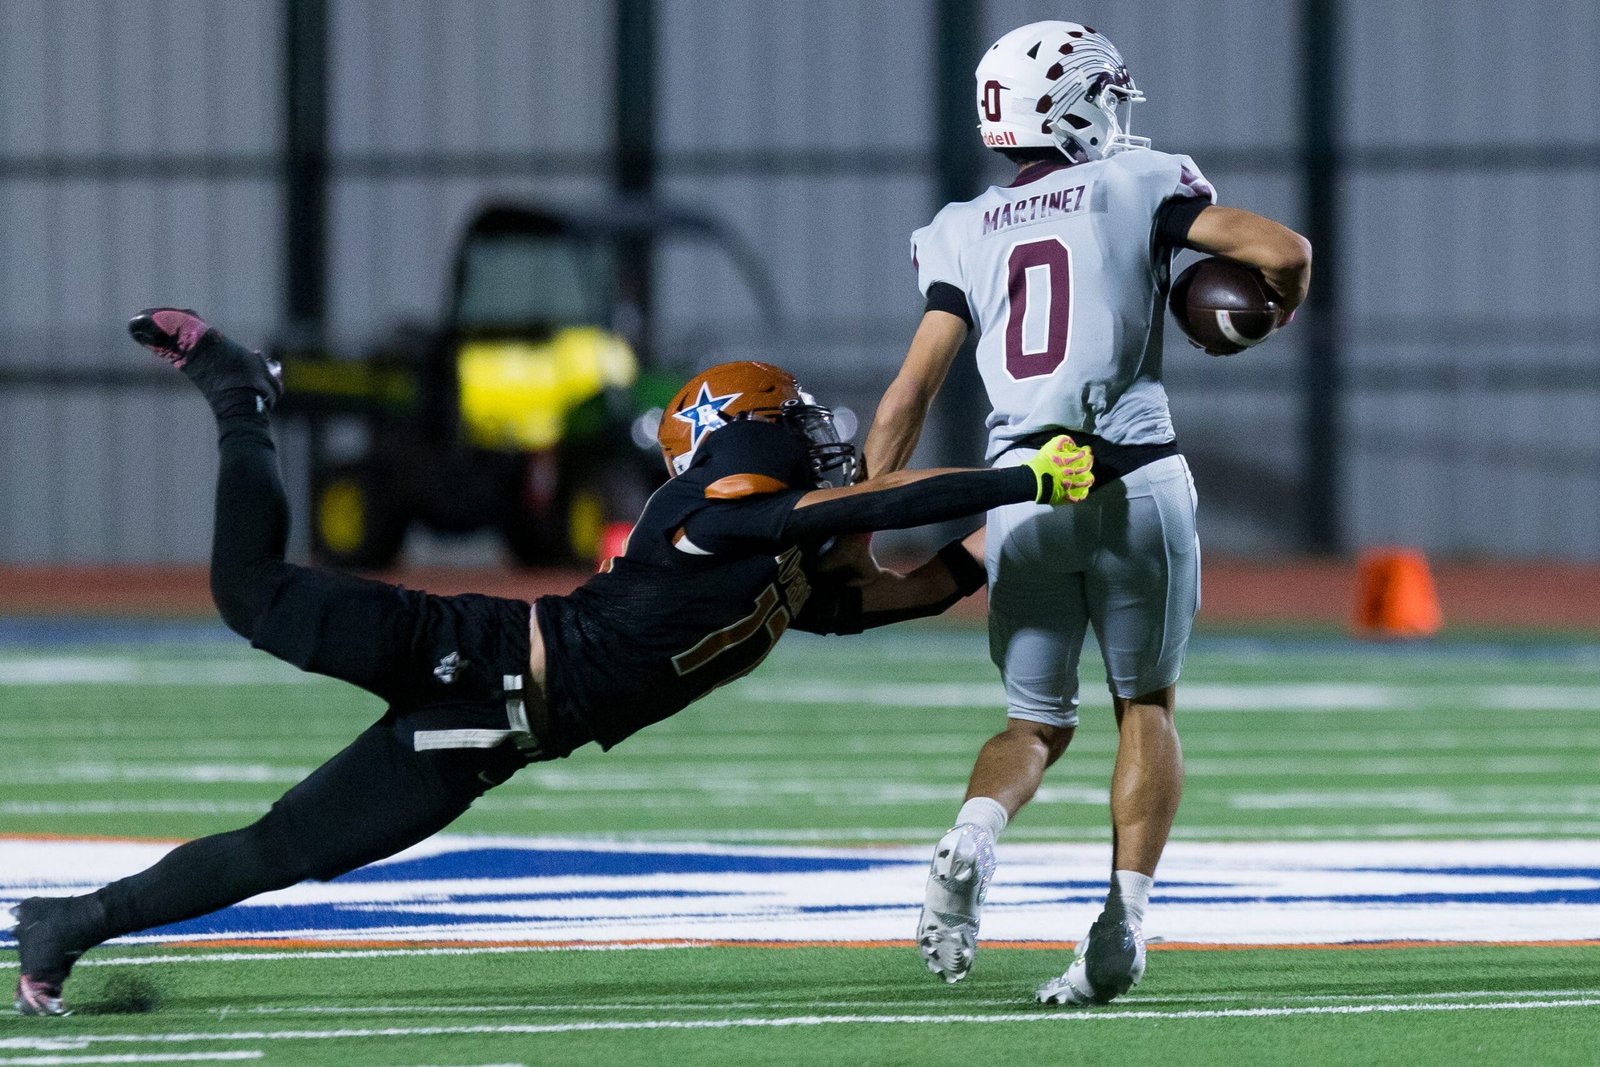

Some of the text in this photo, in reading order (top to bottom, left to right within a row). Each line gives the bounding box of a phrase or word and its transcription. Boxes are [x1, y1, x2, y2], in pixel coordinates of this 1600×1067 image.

[984, 80, 1001, 122] 0
[982, 185, 1086, 235] MARTINEZ
[1004, 235, 1072, 382] 0
